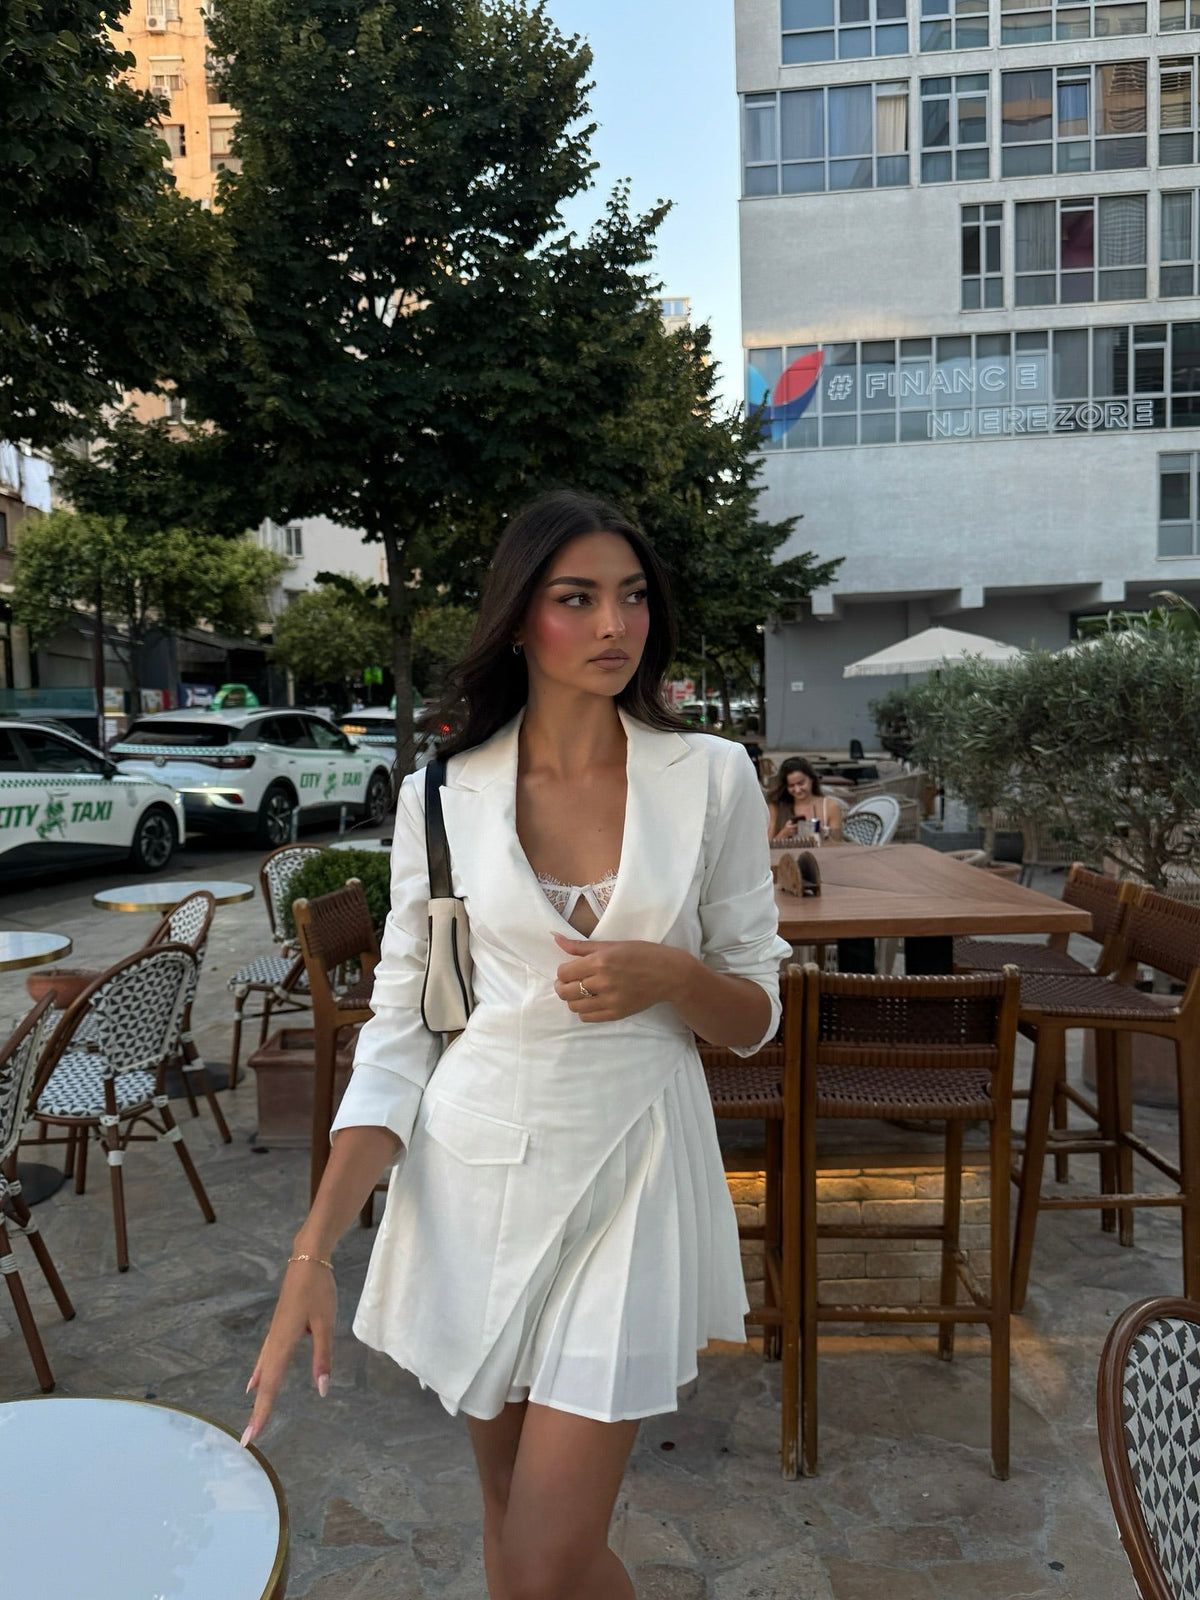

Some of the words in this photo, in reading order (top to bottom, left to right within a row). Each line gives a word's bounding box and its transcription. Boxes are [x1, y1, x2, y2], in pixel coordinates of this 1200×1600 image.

[828, 374, 854, 400] #
[866, 365, 1038, 398] FINANCE
[927, 400, 1154, 438] NJEREZORE
[299, 772, 322, 789] CITY
[342, 771, 363, 786] TAXI
[71, 800, 113, 822] TAXI
